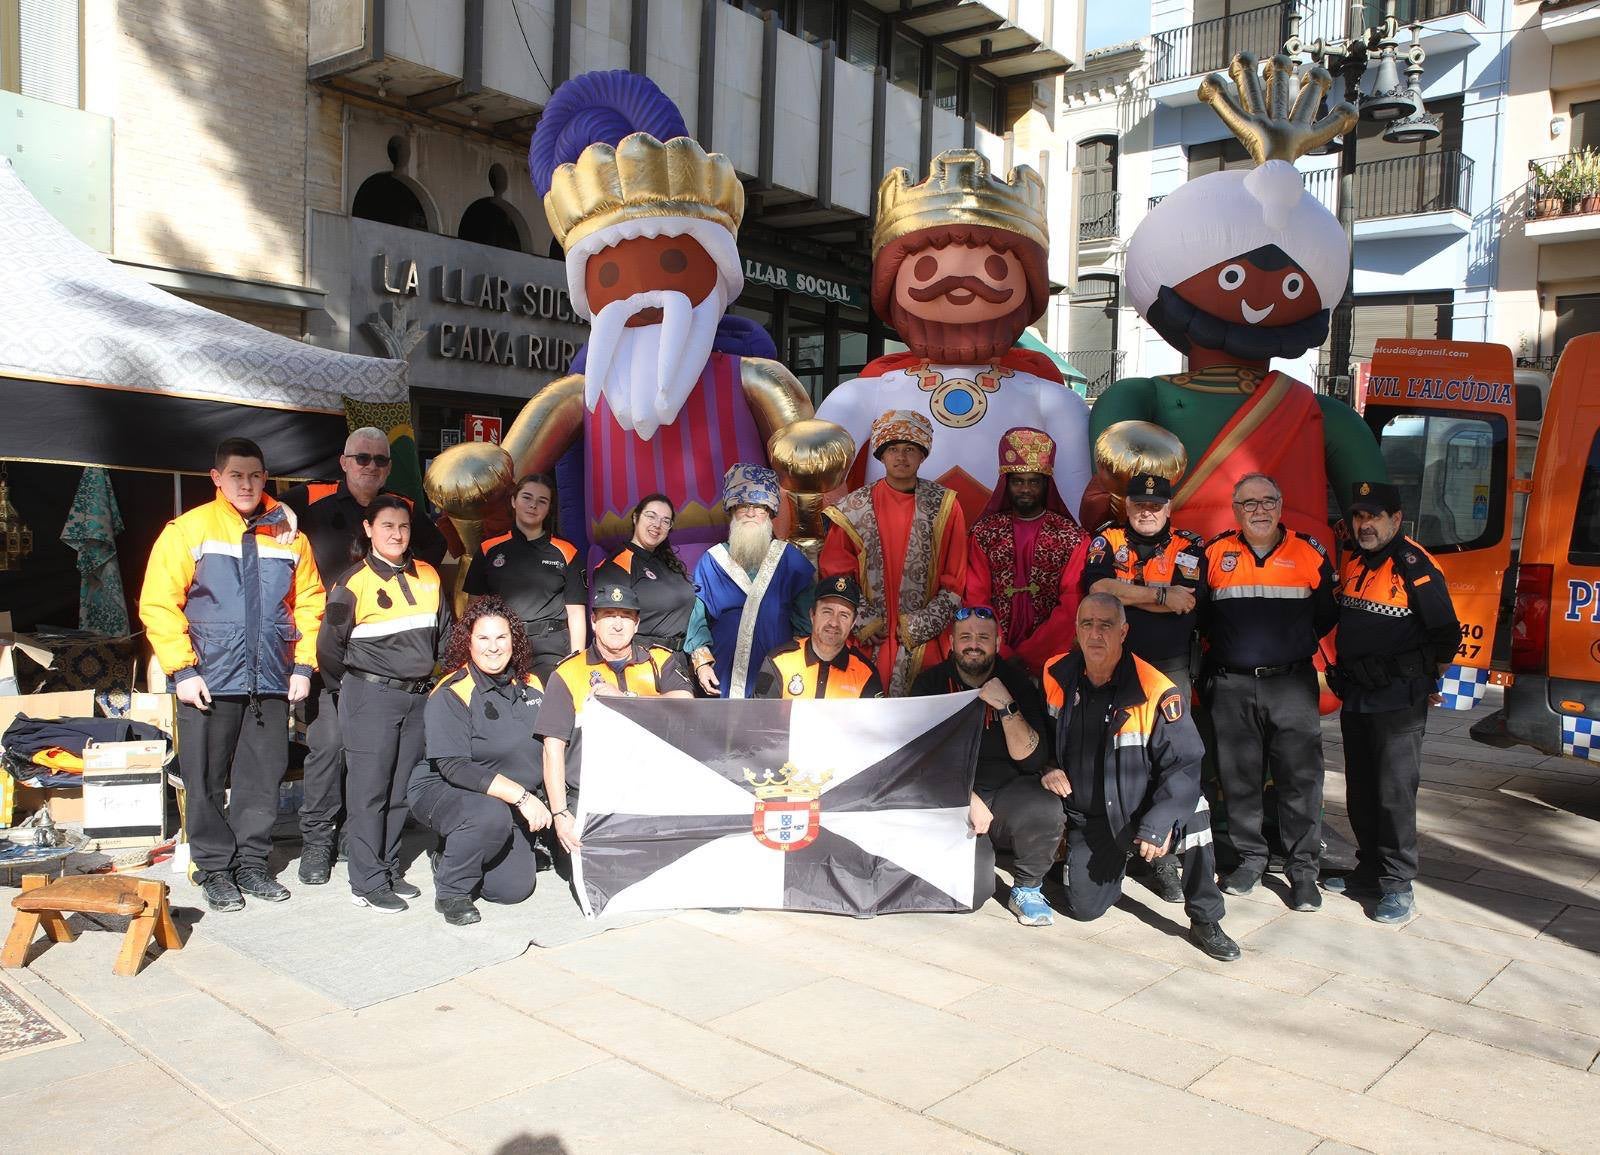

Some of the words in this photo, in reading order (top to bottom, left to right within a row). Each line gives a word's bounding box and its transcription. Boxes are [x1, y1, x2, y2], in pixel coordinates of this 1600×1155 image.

[379, 251, 420, 297] LA
[439, 263, 511, 313] LLAR
[522, 282, 584, 325] SOC
[745, 259, 788, 287] LLAR
[796, 273, 851, 301] SOCIAL
[439, 320, 517, 367] CAIXA
[1406, 374, 1513, 405] L'ALCÚDIA
[1460, 623, 1484, 640] 40
[1457, 643, 1482, 659] 47
